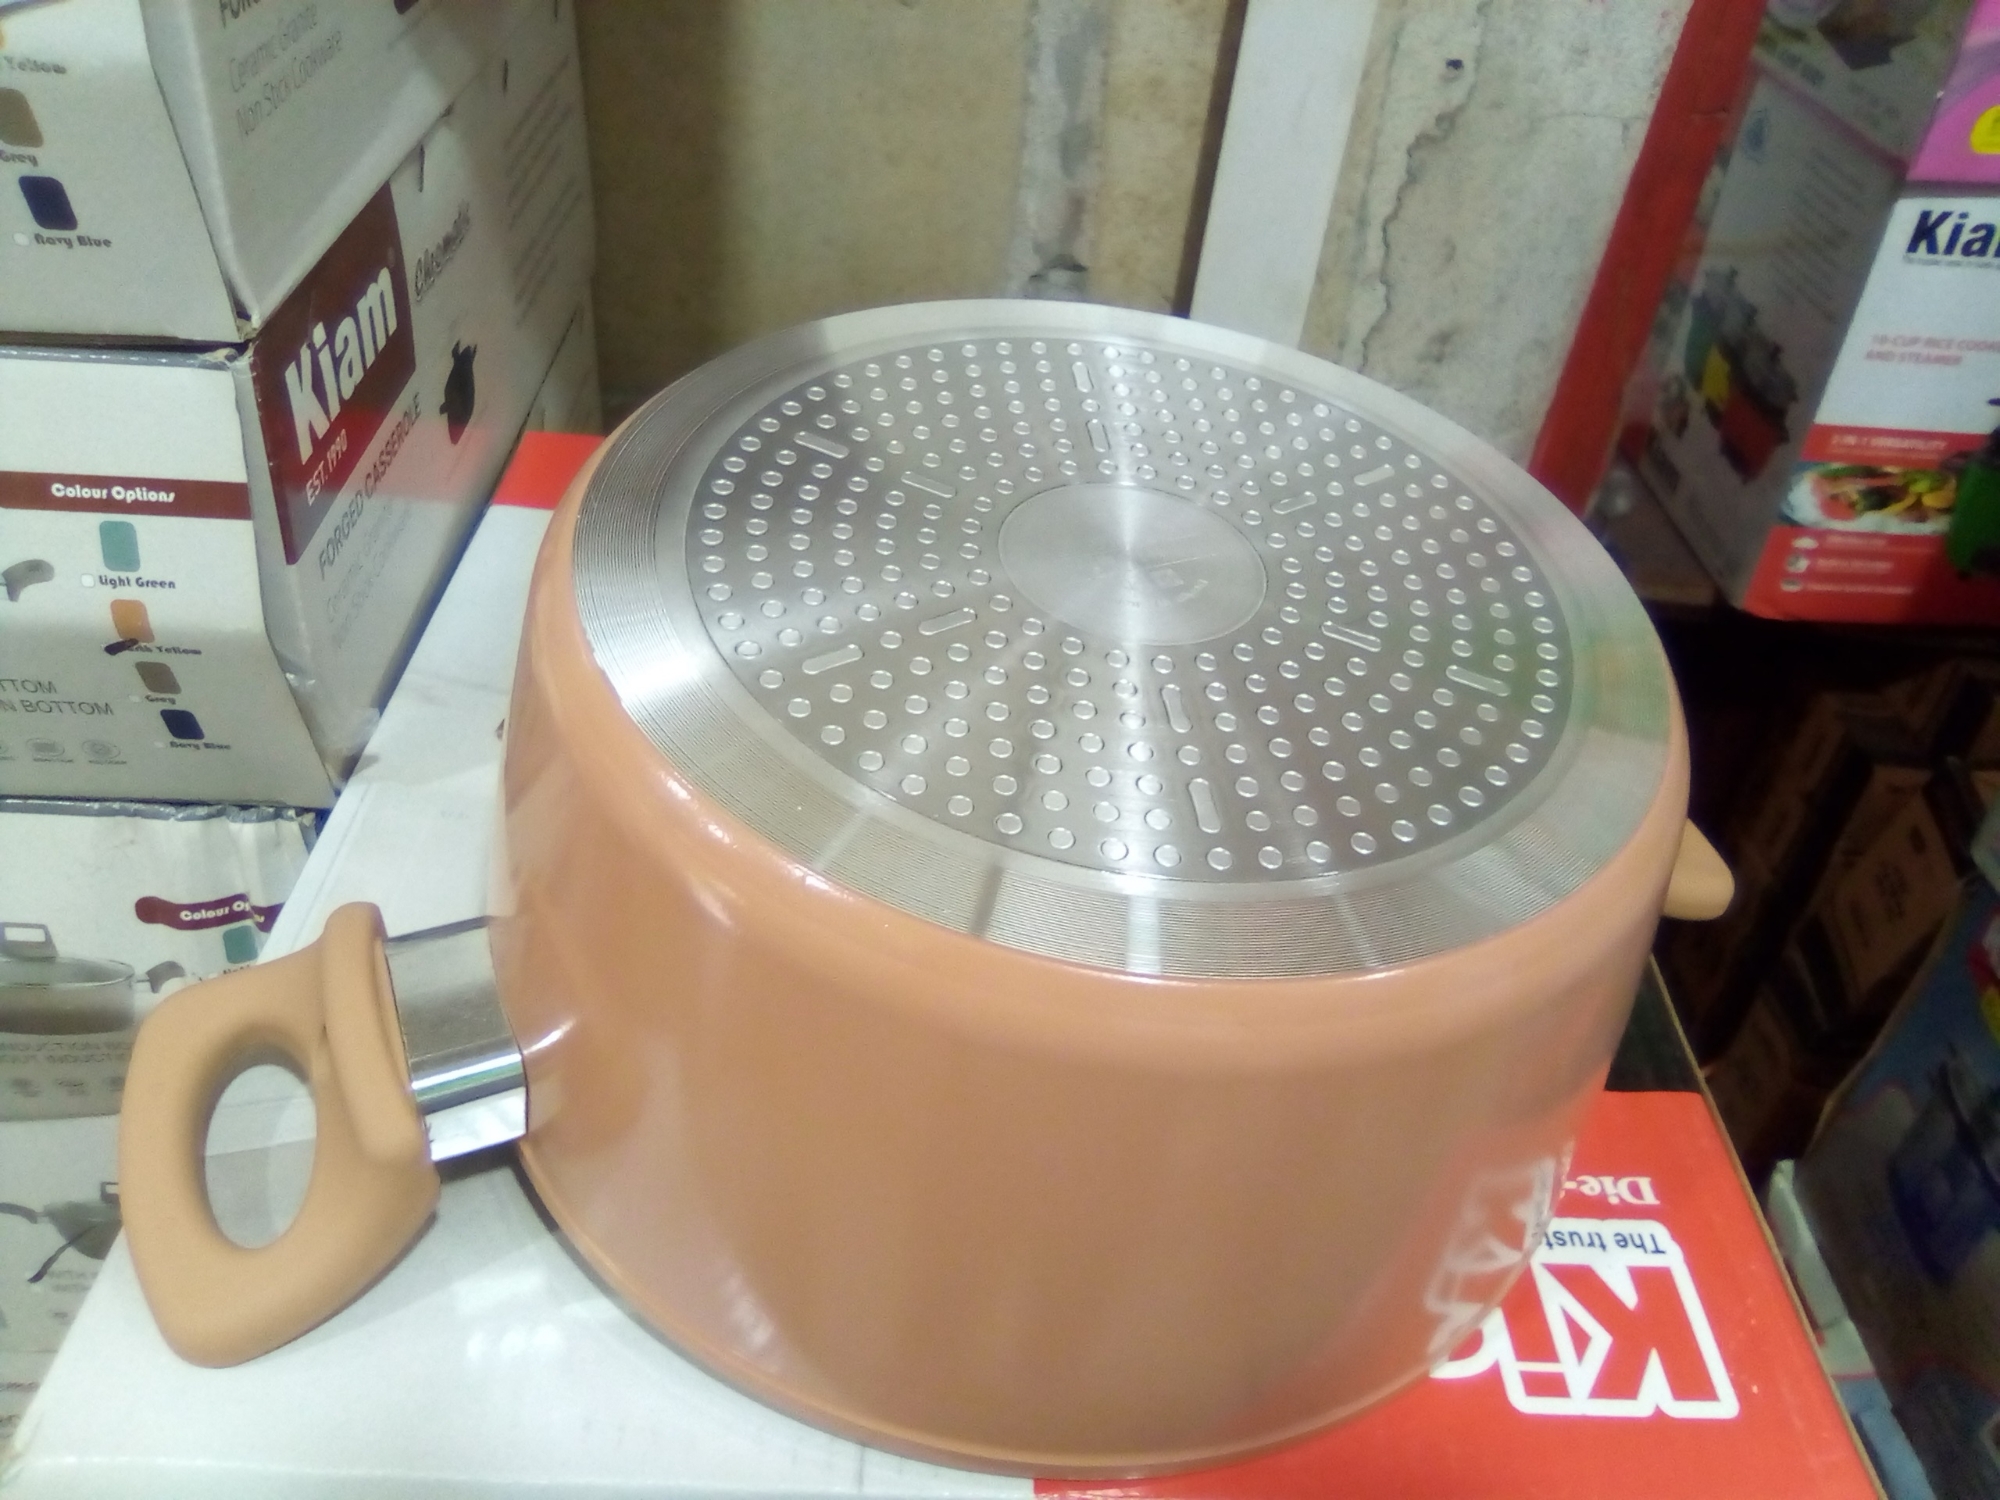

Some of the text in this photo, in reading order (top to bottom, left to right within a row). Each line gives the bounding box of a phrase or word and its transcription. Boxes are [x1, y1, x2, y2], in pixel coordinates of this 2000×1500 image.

[284, 266, 398, 465] Kiam
[305, 428, 348, 507] EST. 1990
[51, 482, 176, 503] Colour Options
[318, 489, 365, 581] FORGED
[364, 391, 423, 500] CASSEROLE
[98, 574, 176, 589] Light Green
[0, 678, 57, 694] TTOM
[20, 699, 115, 715] BOTTOM
[180, 906, 230, 922] Colour
[1558, 1175, 1661, 1205] Die-
[1544, 1230, 1667, 1255] The trust
[1430, 1261, 1740, 1419] Ki
